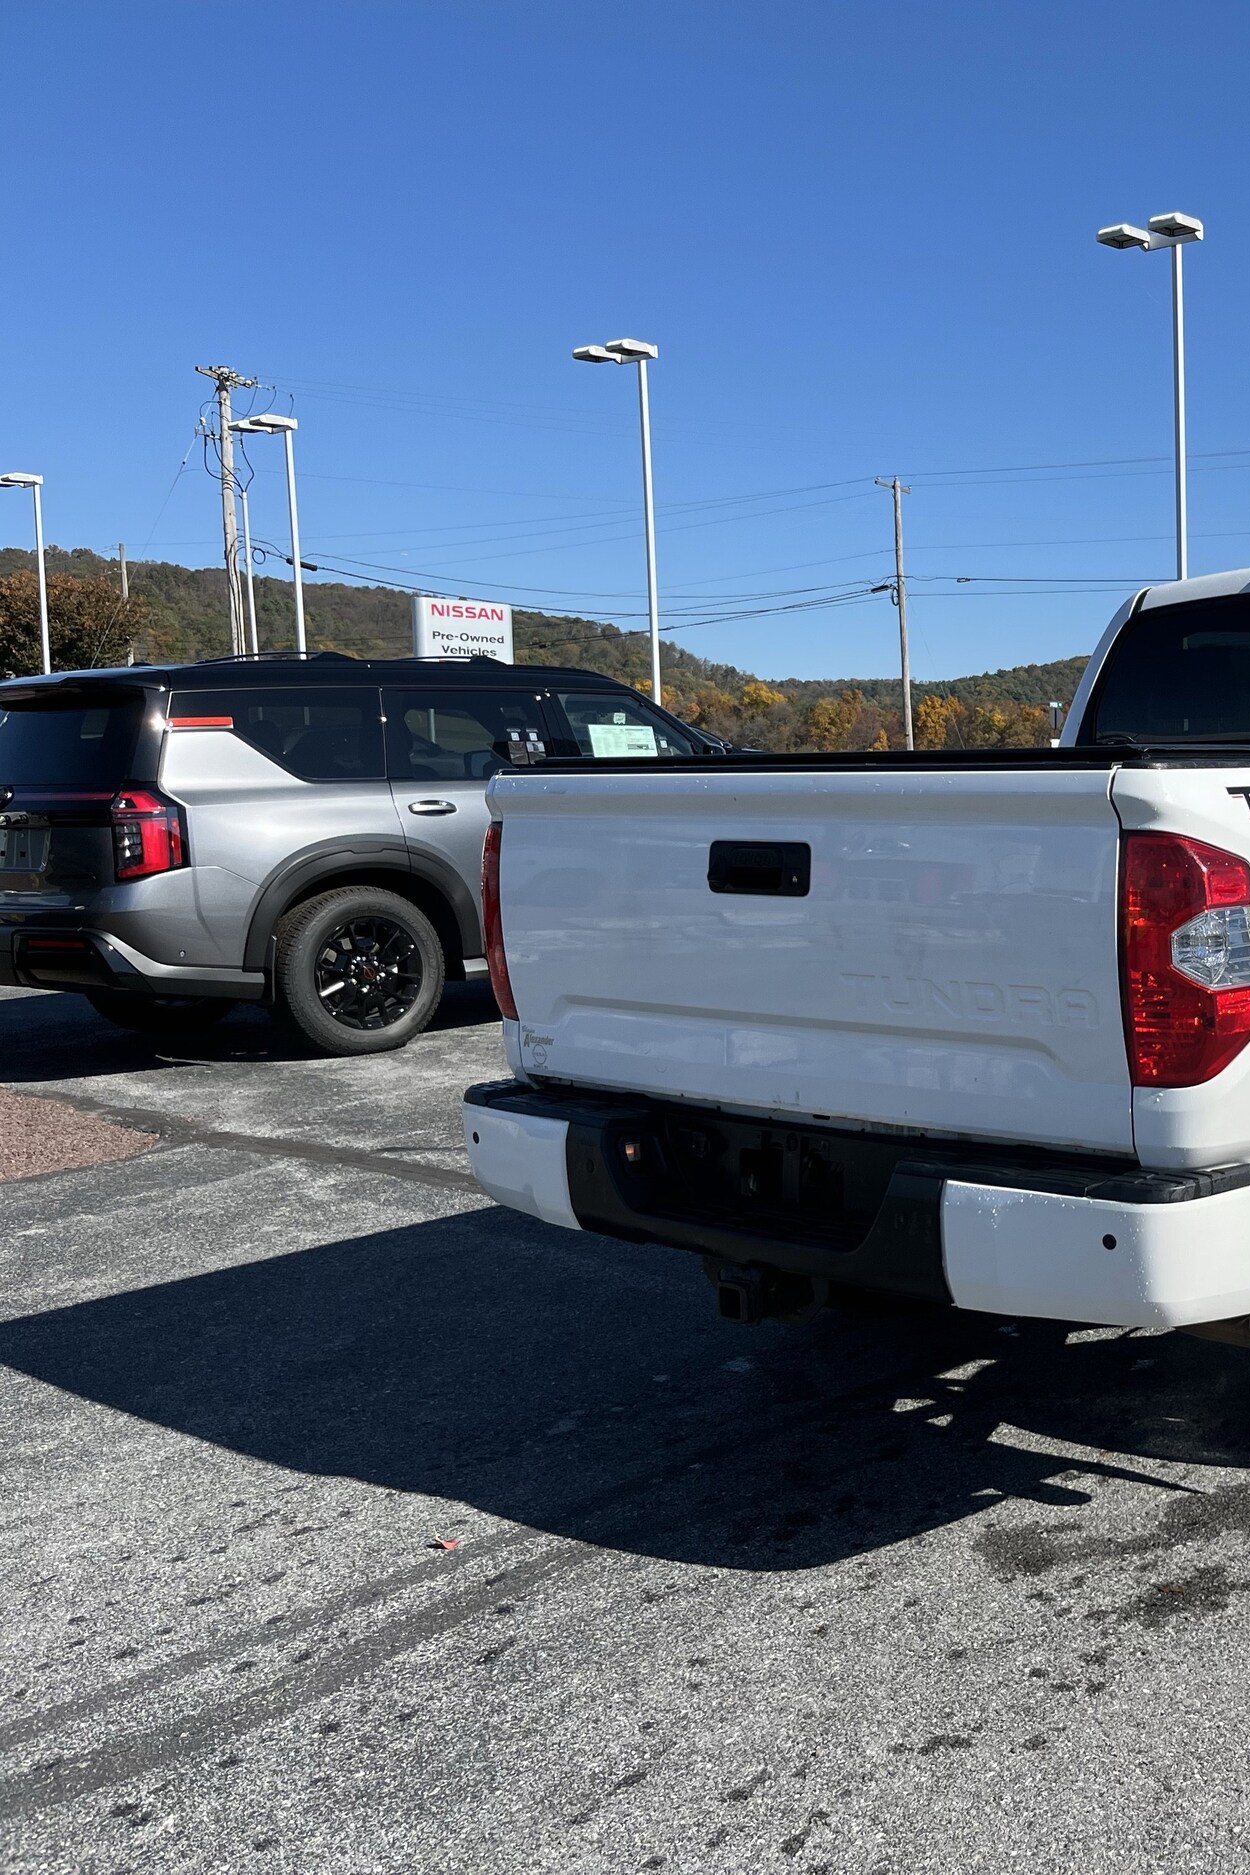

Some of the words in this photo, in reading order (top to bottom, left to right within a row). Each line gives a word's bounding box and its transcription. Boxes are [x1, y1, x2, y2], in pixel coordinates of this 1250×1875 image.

[431, 604, 503, 621] NISSAN
[432, 631, 504, 644] Pre-Owned
[442, 645, 497, 657] Vehicles
[840, 973, 1099, 1030] TUNDRA
